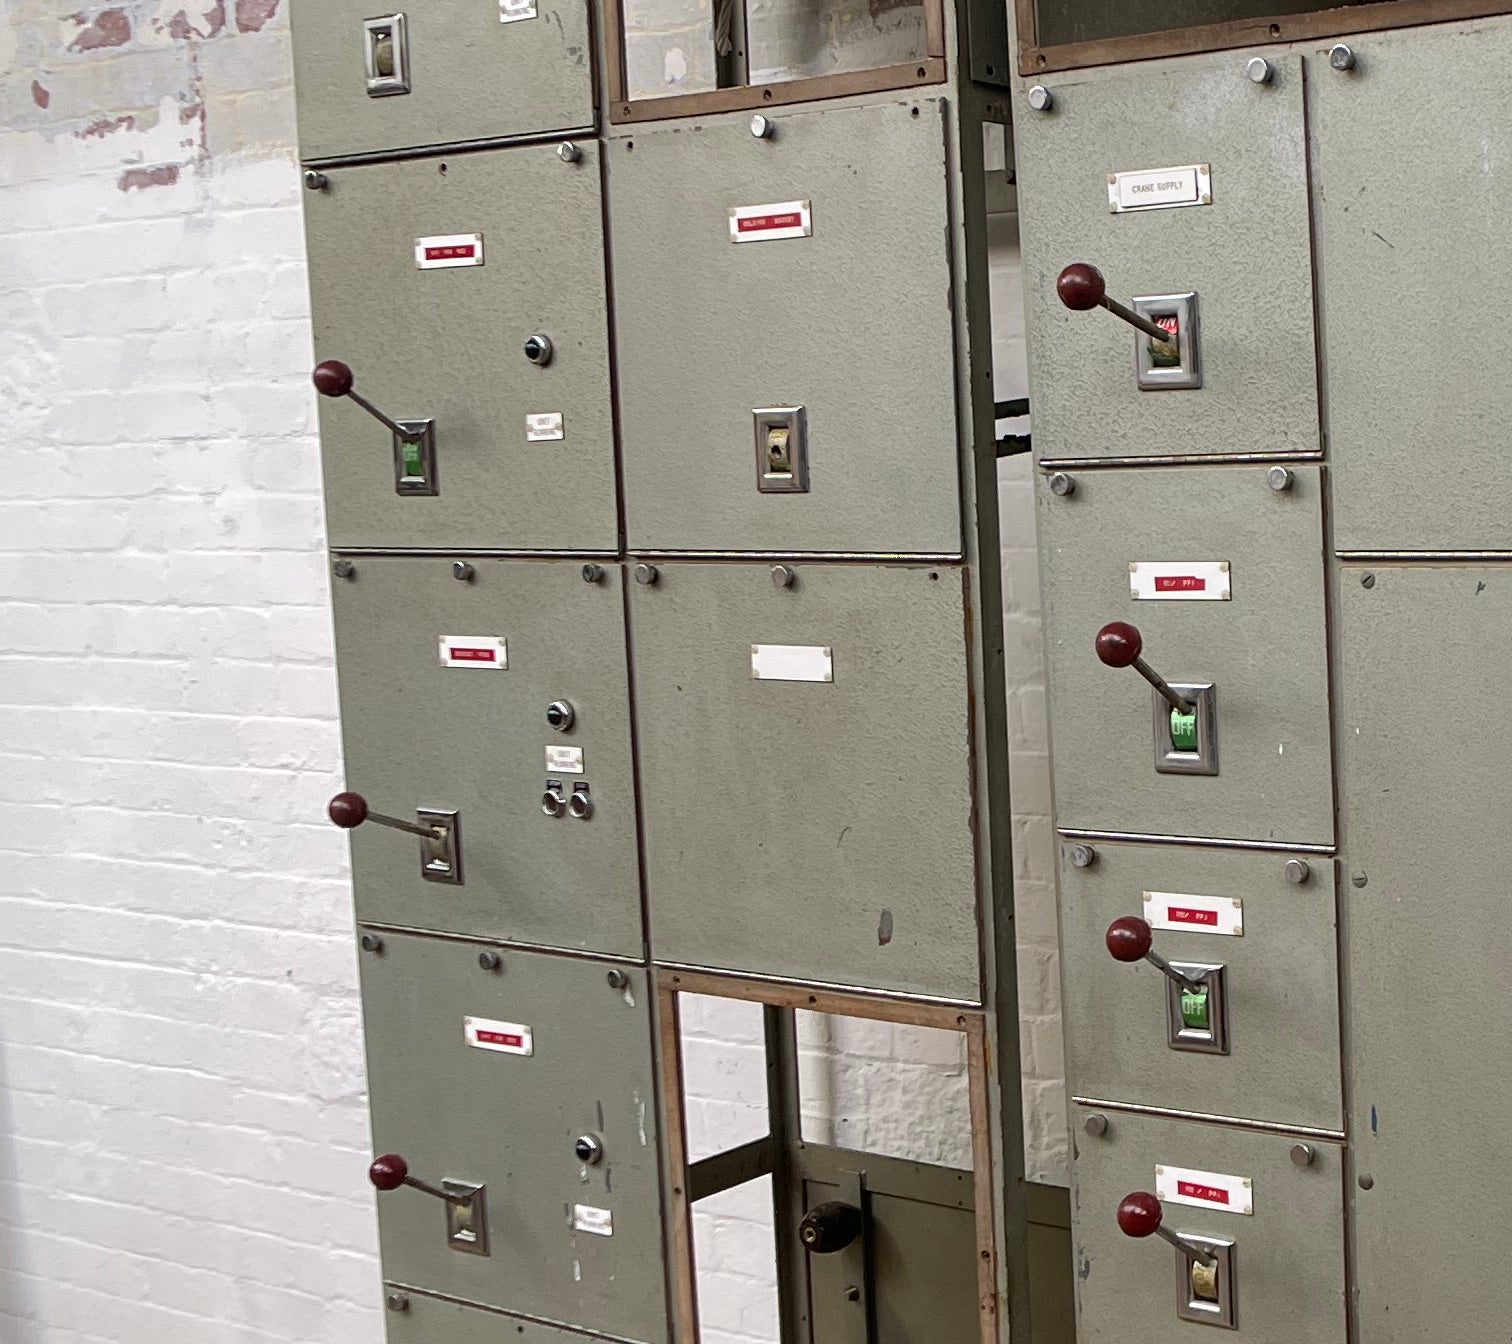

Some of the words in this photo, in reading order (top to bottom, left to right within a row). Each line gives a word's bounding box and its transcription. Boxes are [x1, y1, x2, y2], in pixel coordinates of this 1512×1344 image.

[1131, 183, 1155, 194] CRANE
[1157, 180, 1183, 192] SUPPLY
[1171, 719, 1195, 737] OFF
[1181, 997, 1204, 1016] OFF
